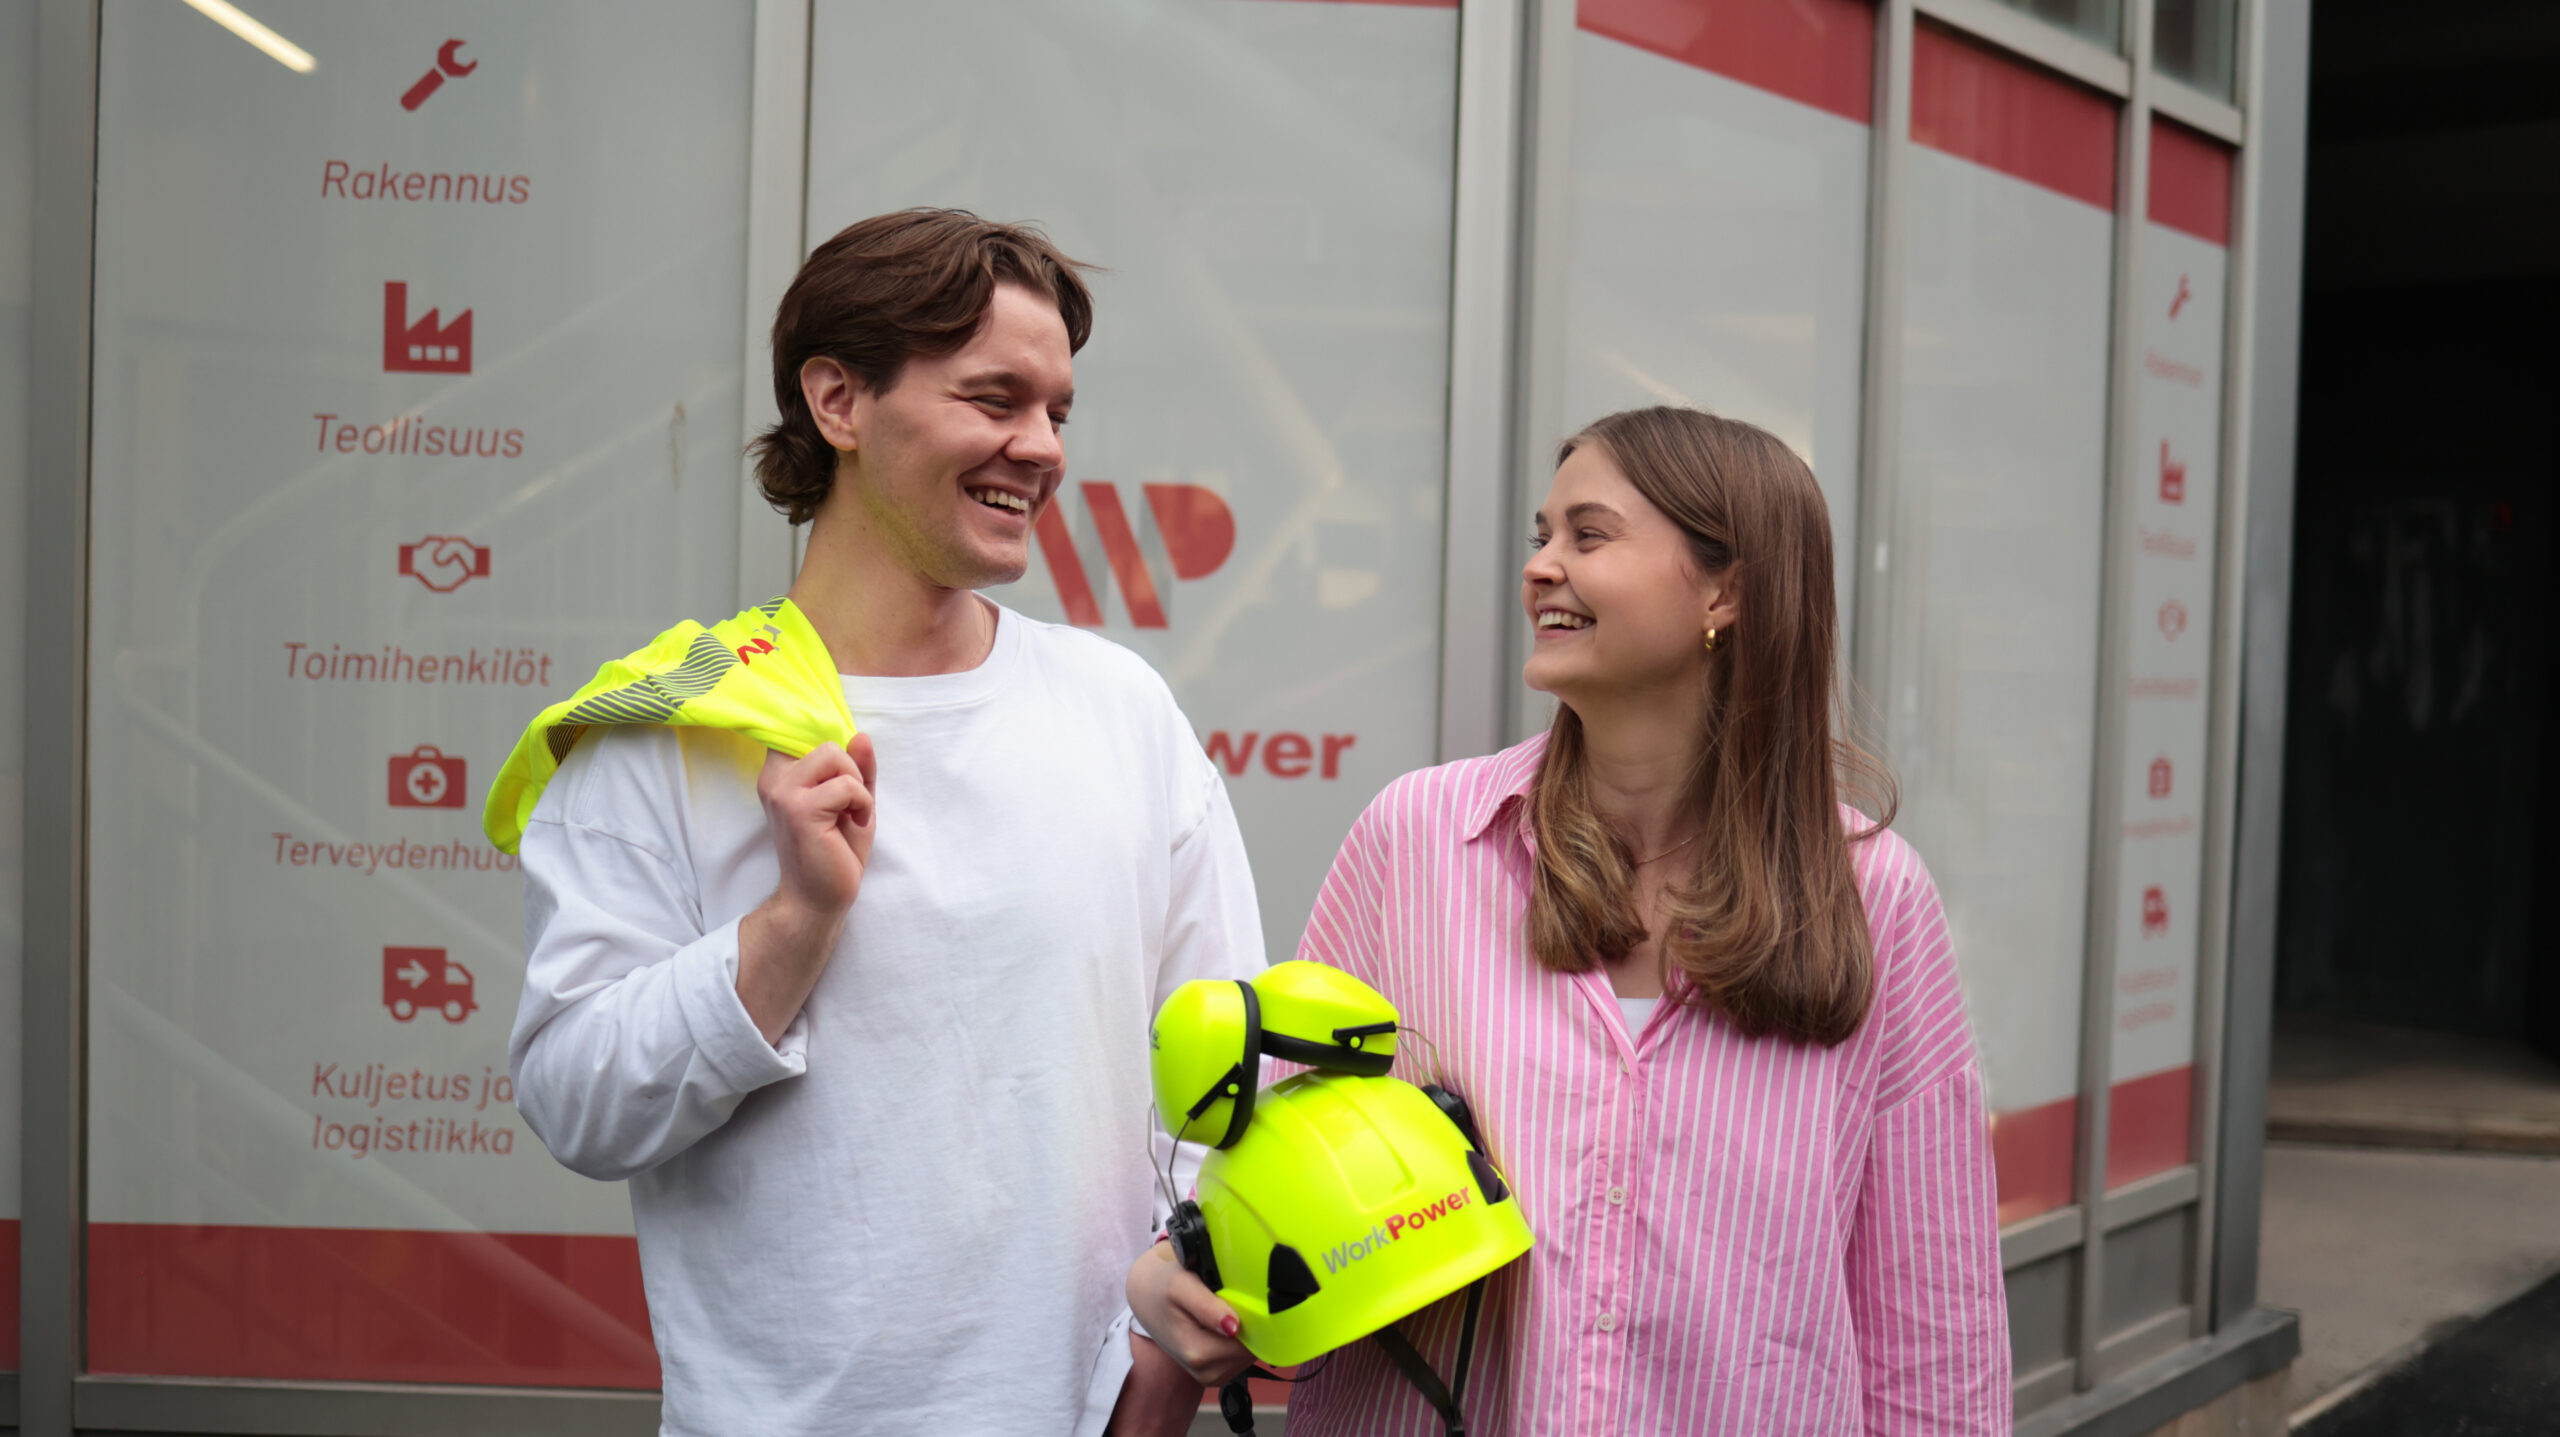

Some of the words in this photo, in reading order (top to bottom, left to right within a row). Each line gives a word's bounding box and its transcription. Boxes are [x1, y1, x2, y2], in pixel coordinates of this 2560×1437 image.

[321, 159, 531, 204] Rakennus
[313, 413, 525, 458] Teollisuus
[283, 641, 553, 686] Toimihenkilöt
[1199, 729, 1357, 781] wer
[271, 832, 522, 876] Terveydenhuo
[311, 1062, 472, 1109] Kuljetus
[475, 1065, 515, 1112] ja
[312, 1114, 515, 1160] logistiikka
[1321, 1186, 1472, 1275] WorkPower
